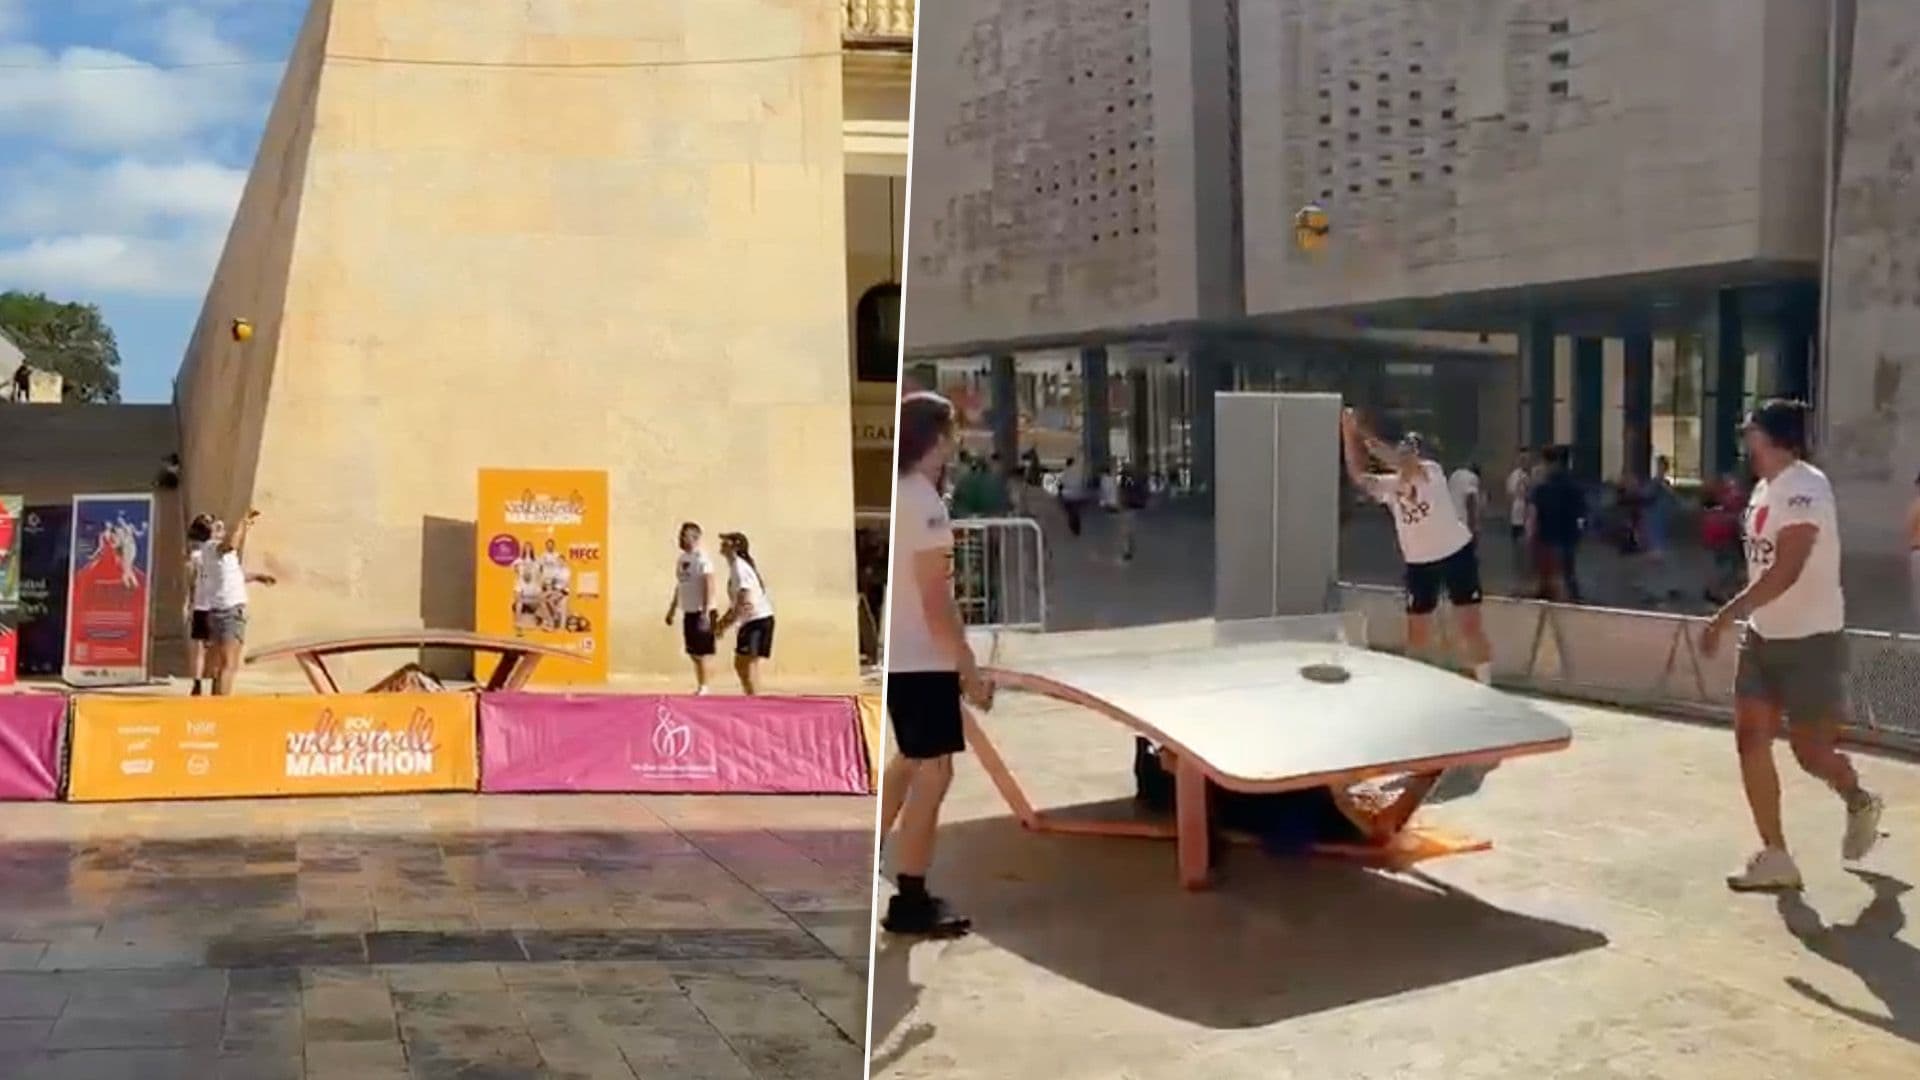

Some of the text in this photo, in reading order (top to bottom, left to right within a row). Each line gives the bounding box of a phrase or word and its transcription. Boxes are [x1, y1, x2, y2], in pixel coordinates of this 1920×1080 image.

[569, 548, 600, 560] MFCC
[344, 716, 372, 729] BOV
[286, 752, 434, 777] MARATHON
